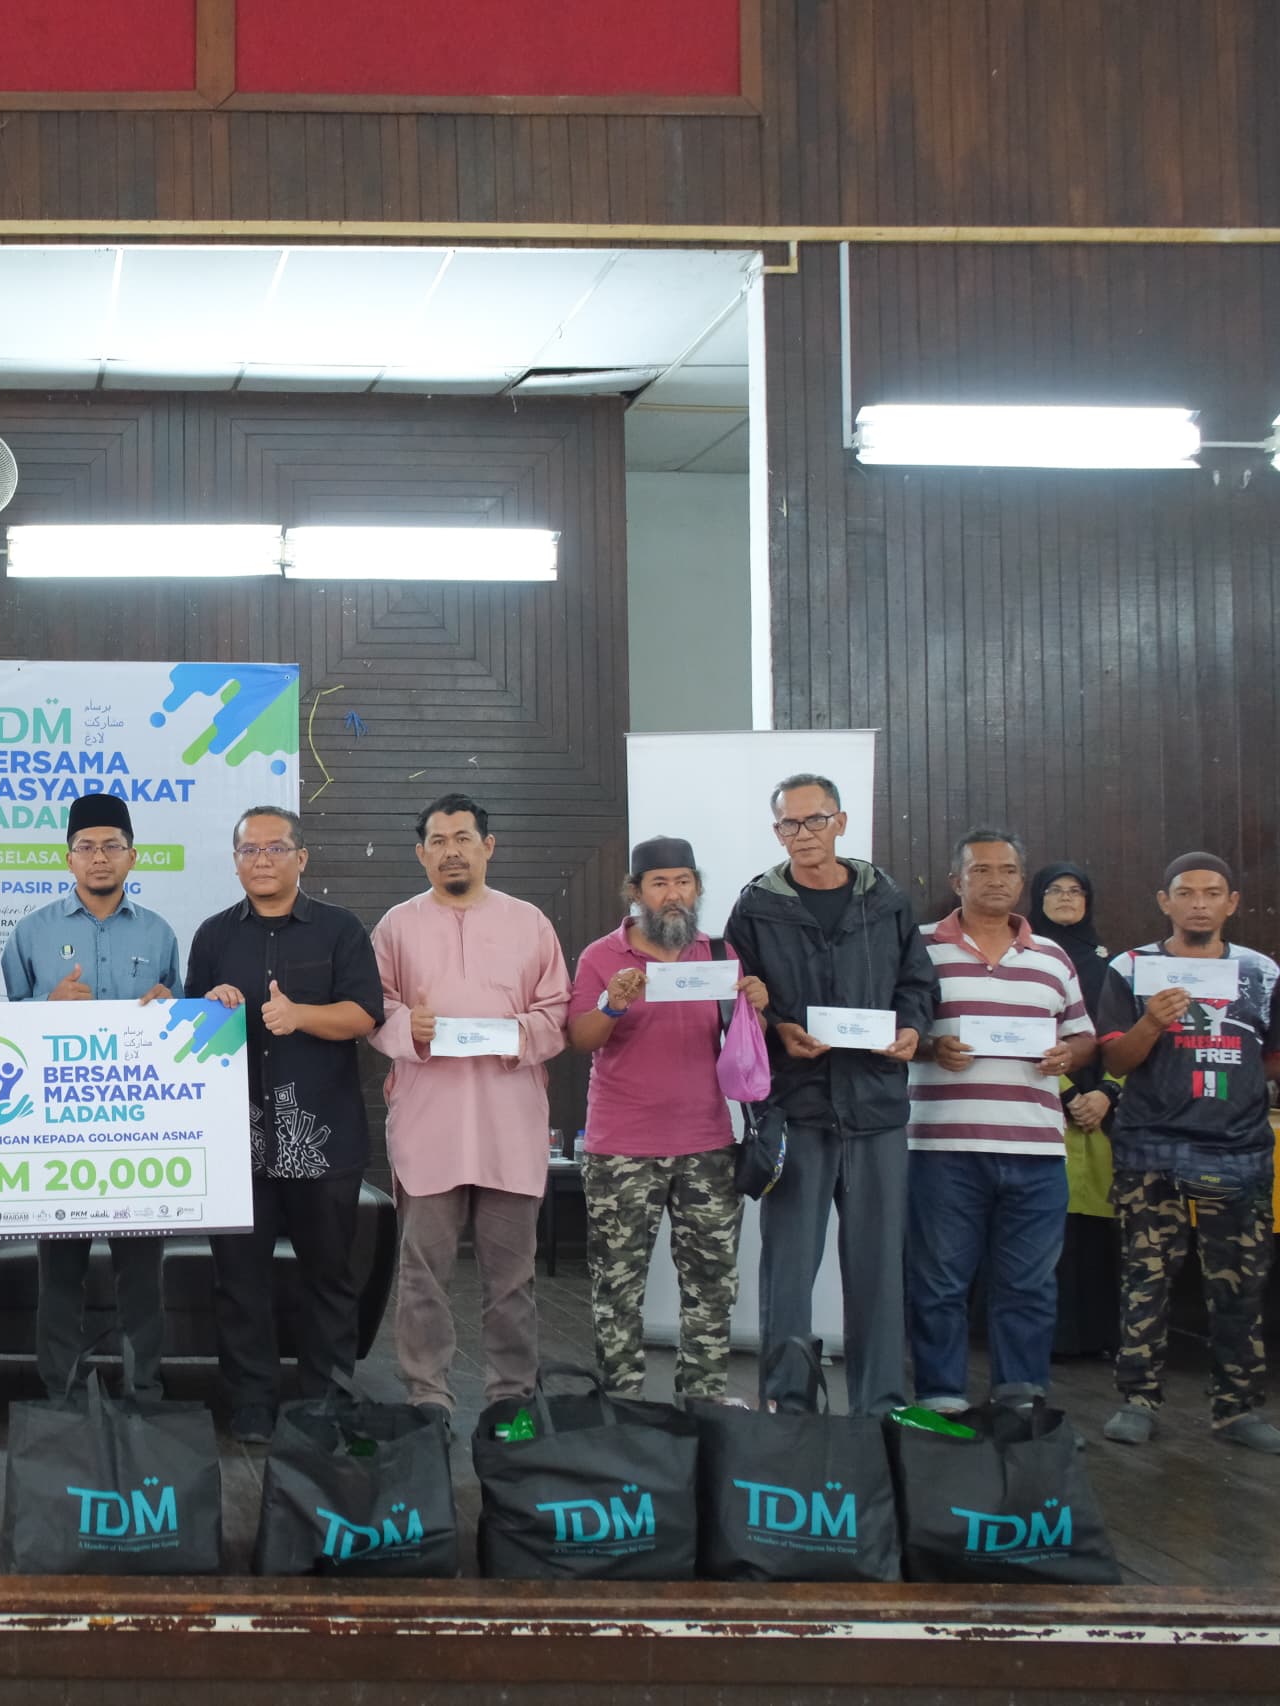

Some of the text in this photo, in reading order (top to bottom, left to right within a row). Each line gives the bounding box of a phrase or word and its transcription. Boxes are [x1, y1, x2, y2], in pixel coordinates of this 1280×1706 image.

[1, 881, 53, 894] PASIR
[42, 1027, 117, 1062] TDM
[1174, 1035, 1242, 1050] PALESTINE
[1195, 1048, 1242, 1064] FREE
[44, 1064, 159, 1084] BERSAMA
[44, 1083, 206, 1104] MASYARAKAT
[45, 1104, 145, 1124] LADANG
[33, 1133, 86, 1145] KEPADA
[88, 1132, 159, 1144] GOLONGAN
[162, 1130, 204, 1142] ASNAF
[44, 1156, 192, 1197] 20,000
[67, 1476, 178, 1536] TDM
[535, 1483, 655, 1542] TDM
[733, 1479, 857, 1538] TDM
[950, 1498, 1072, 1552] TDM
